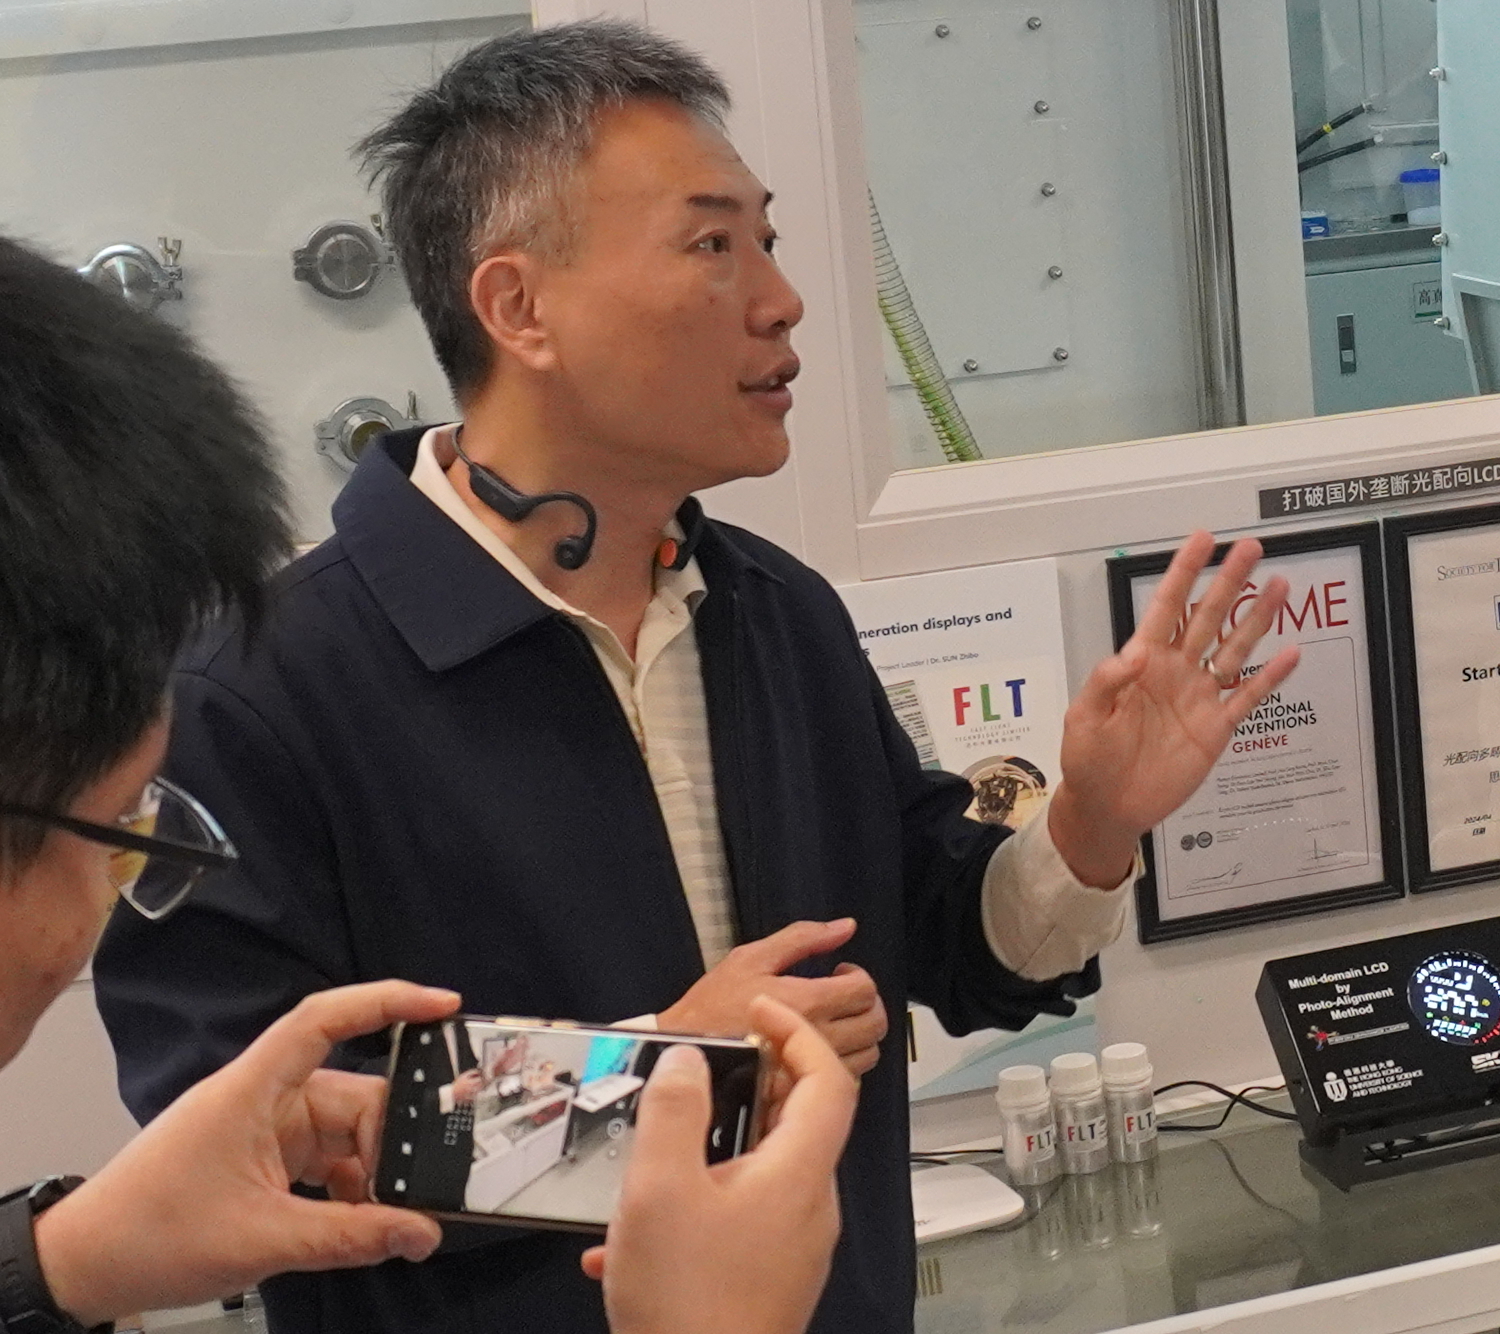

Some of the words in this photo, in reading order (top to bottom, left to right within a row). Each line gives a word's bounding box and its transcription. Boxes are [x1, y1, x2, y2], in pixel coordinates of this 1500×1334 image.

[859, 622, 919, 640] neration
[923, 612, 981, 631] displays
[986, 608, 1013, 622] and
[953, 678, 1026, 726] FLT
[1241, 701, 1313, 722] NATIONAL
[1235, 713, 1317, 737] NVENTIONS
[1232, 734, 1289, 754] GENÈVE
[1288, 968, 1362, 989] Multi-domain
[1363, 962, 1389, 975] LCD
[1335, 983, 1350, 994] by
[1298, 987, 1394, 1013] Photo-Alignment
[1330, 1004, 1374, 1020] Method
[1067, 1123, 1095, 1142] FLT
[1126, 1111, 1153, 1133] FLT
[1026, 1130, 1050, 1152] FLT
